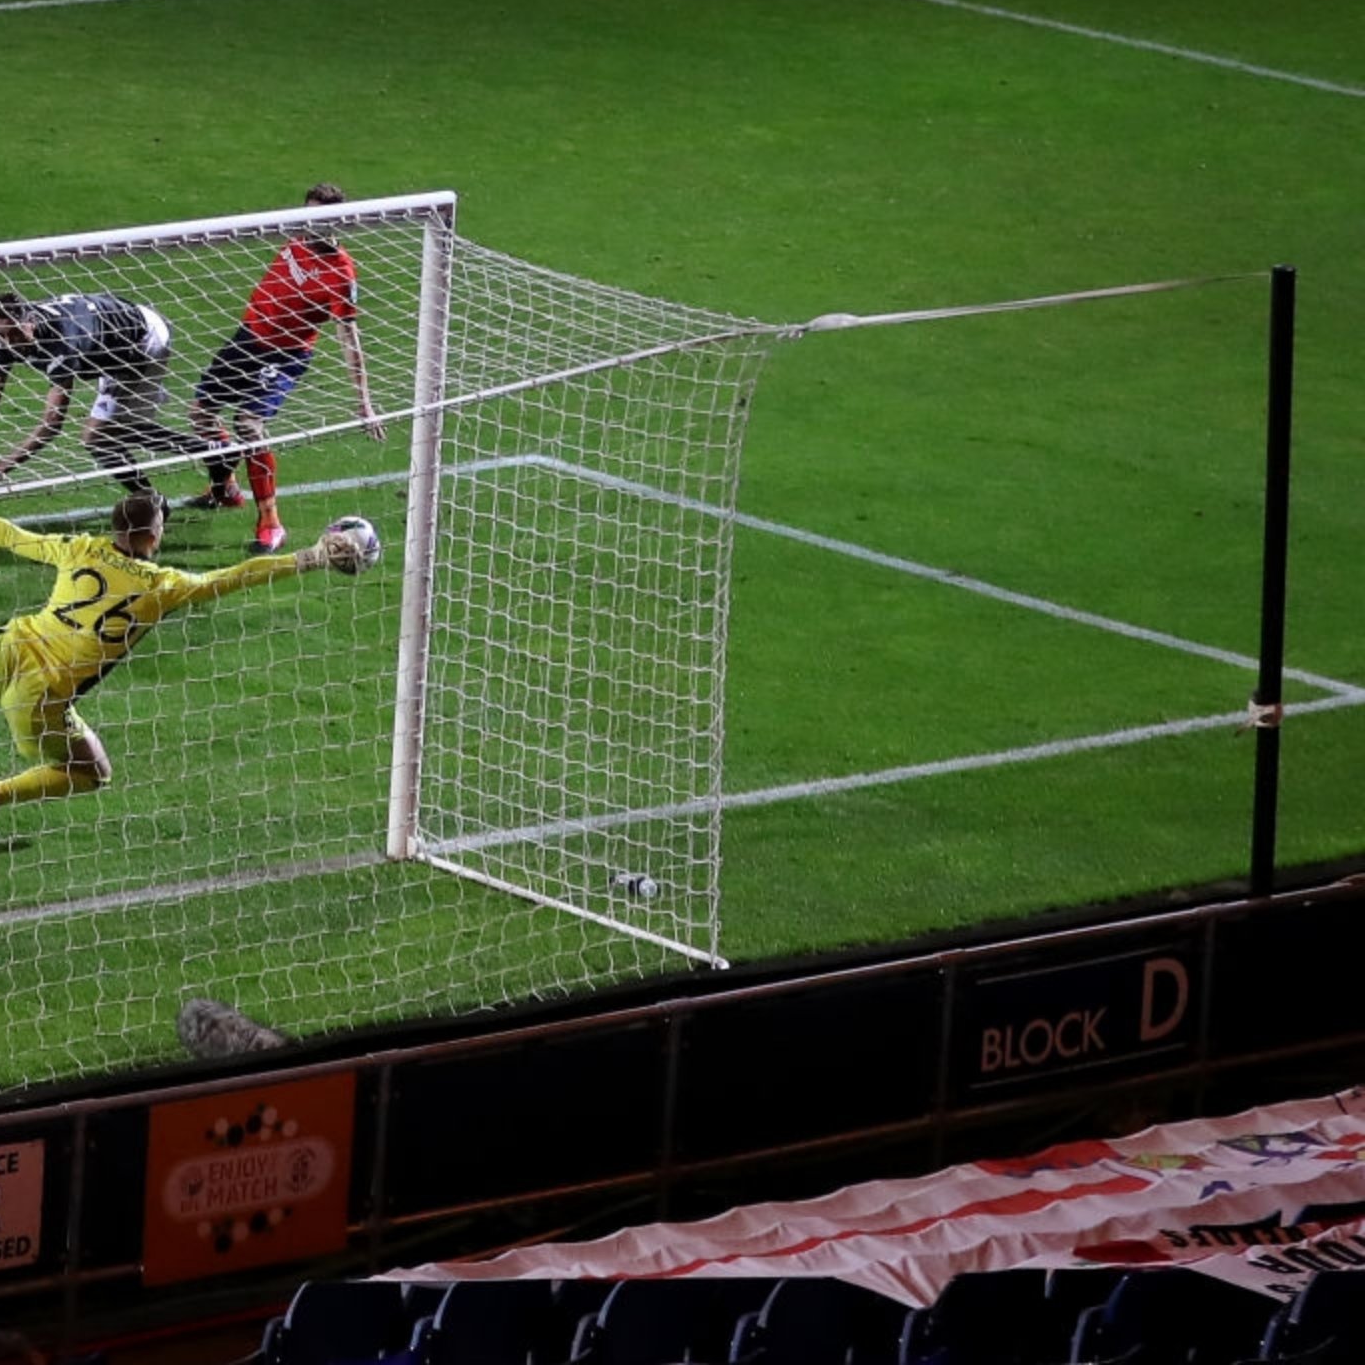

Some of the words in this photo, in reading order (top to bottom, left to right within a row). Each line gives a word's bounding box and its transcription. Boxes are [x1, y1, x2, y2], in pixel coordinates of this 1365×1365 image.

[53, 566, 142, 644] 26
[980, 1005, 1109, 1074] BLOCK
[1139, 956, 1189, 1043] D
[207, 1175, 278, 1209] MATCH
[208, 1153, 269, 1186] ENJOY
